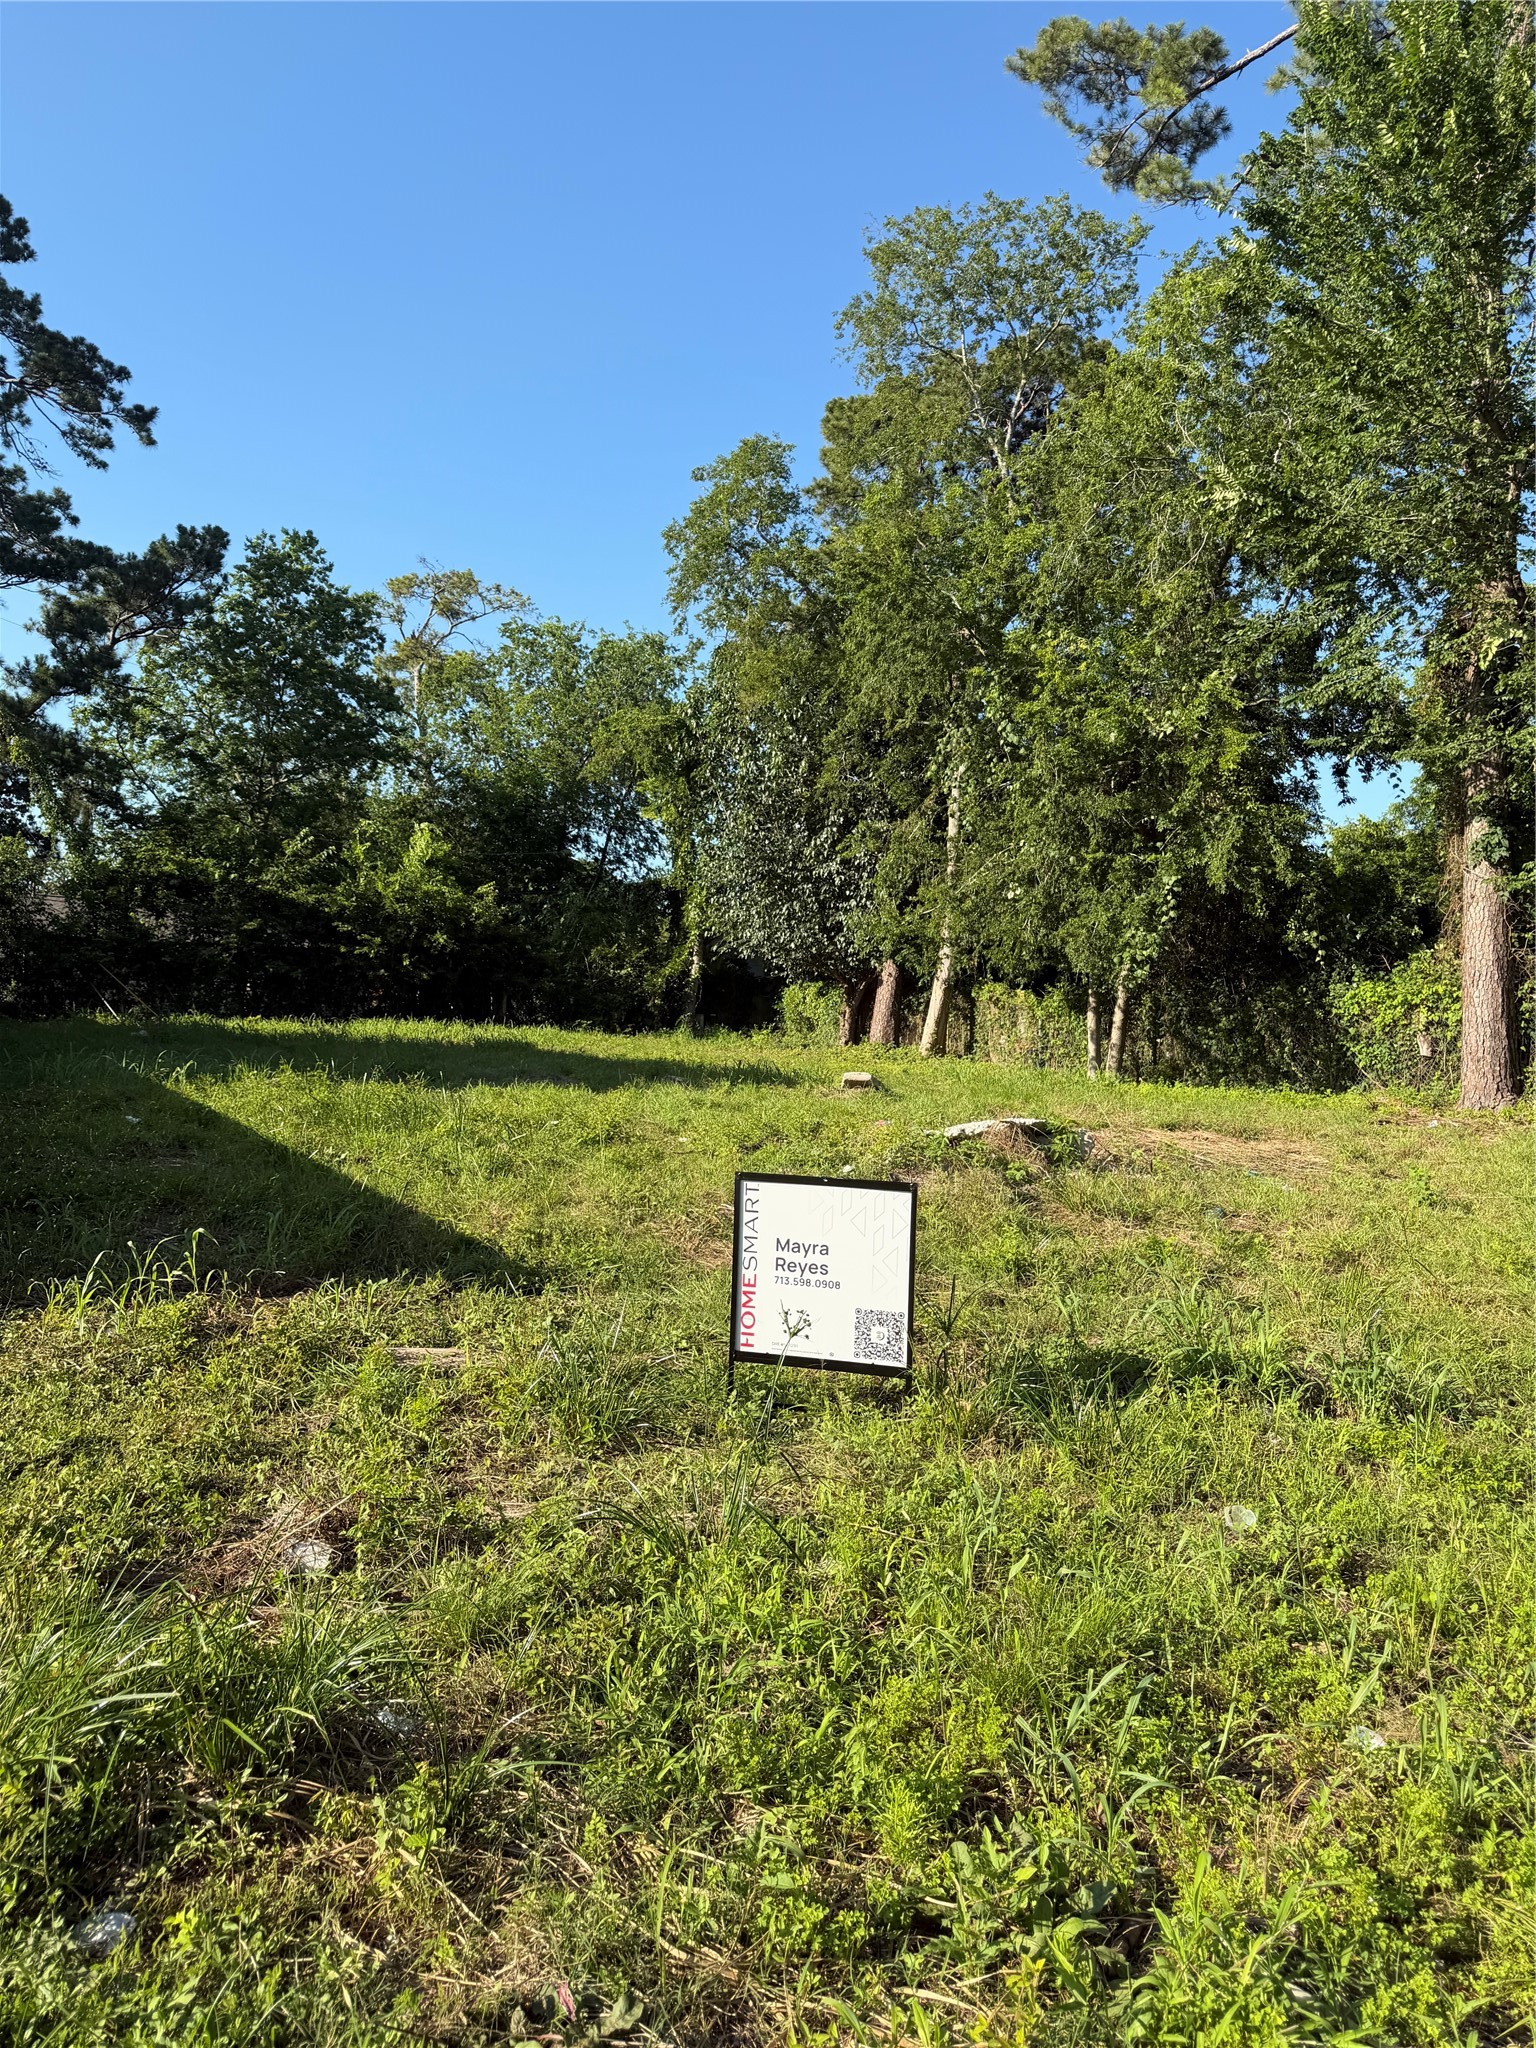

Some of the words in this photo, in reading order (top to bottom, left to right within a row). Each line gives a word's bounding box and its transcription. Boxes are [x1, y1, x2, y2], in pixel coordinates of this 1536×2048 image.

[775, 1237, 829, 1258] Mayra
[740, 1182, 759, 1347] HOMESMART
[775, 1257, 829, 1277] Reyes
[774, 1275, 841, 1290] 713.598.0908
